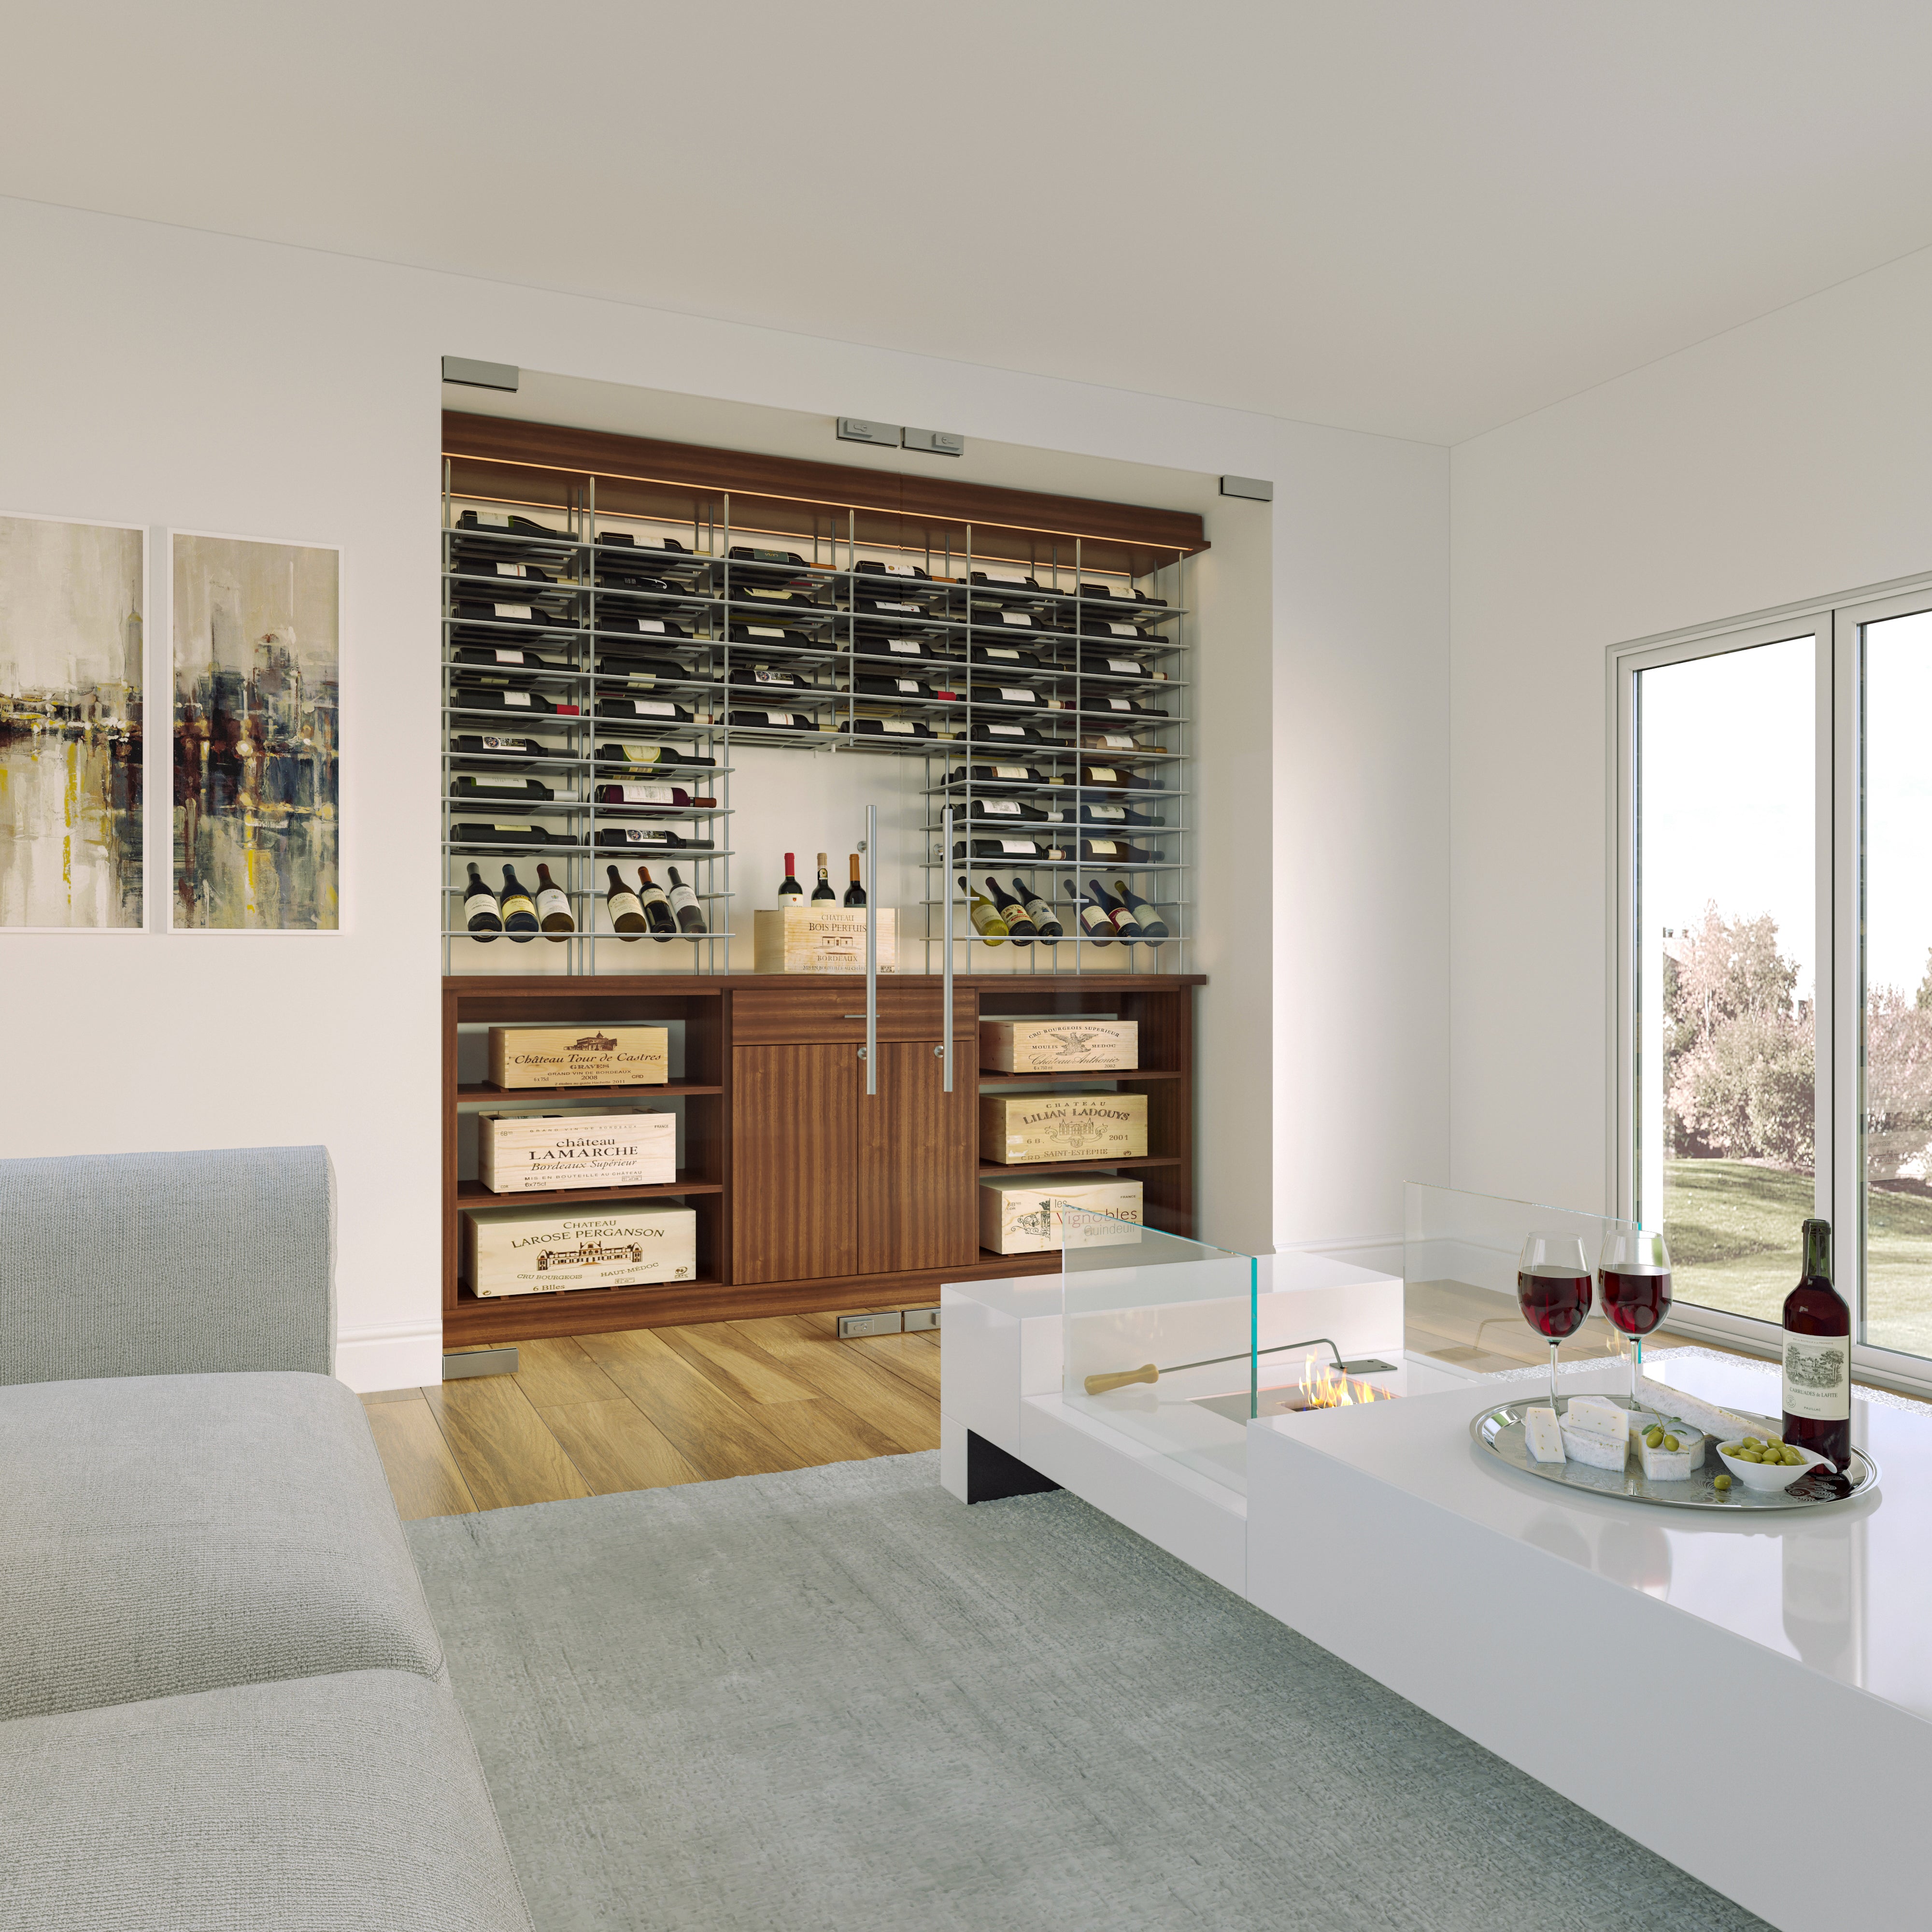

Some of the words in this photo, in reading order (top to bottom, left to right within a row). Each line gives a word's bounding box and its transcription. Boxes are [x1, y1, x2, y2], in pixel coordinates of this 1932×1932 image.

[809, 923, 829, 931] BOIS
[832, 923, 867, 932] PERTUIS
[1085, 1026, 1120, 1037] SUPERIEUR
[515, 1055, 564, 1064] Château
[567, 1054, 597, 1063] Tour
[600, 1053, 612, 1062] de
[617, 1053, 661, 1061] Castres
[1023, 1109, 1066, 1124] LILIAN
[1073, 1108, 1130, 1121] LADOUYS
[556, 1138, 615, 1148] château
[529, 1146, 638, 1160] LAMARCHE
[531, 1162, 586, 1171] Bordeaux
[590, 1159, 637, 1169] Supérieur
[1055, 1199, 1067, 1208] les
[563, 1221, 616, 1229] CHATEAU
[511, 1232, 571, 1248] LAROSE
[576, 1228, 665, 1238] PERGANSON
[601, 1263, 659, 1277] HAUT-MÉDOC
[1790, 1387, 1815, 1396] CARRUADES
